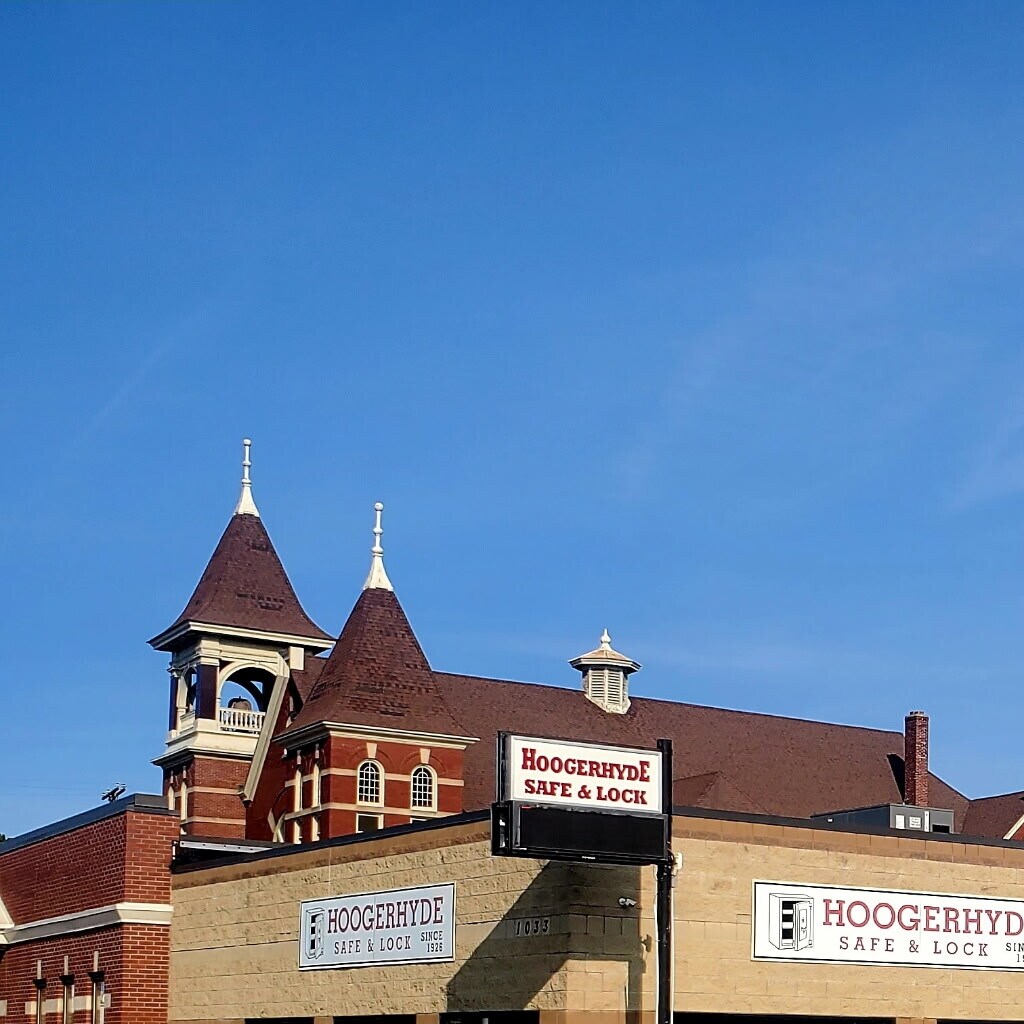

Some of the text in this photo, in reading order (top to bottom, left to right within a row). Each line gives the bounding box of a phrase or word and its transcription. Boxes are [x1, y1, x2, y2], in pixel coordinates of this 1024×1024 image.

[521, 747, 650, 783] HOOGERHYDE
[524, 779, 648, 805] SAFE & LOCK
[327, 896, 444, 934] HOOGERHYDE
[420, 931, 443, 942] SINCE
[516, 919, 549, 936] 1033
[334, 935, 411, 955] SAFE & LOCK
[426, 942, 443, 953] 1926
[839, 936, 989, 957] SAFE & LOCK
